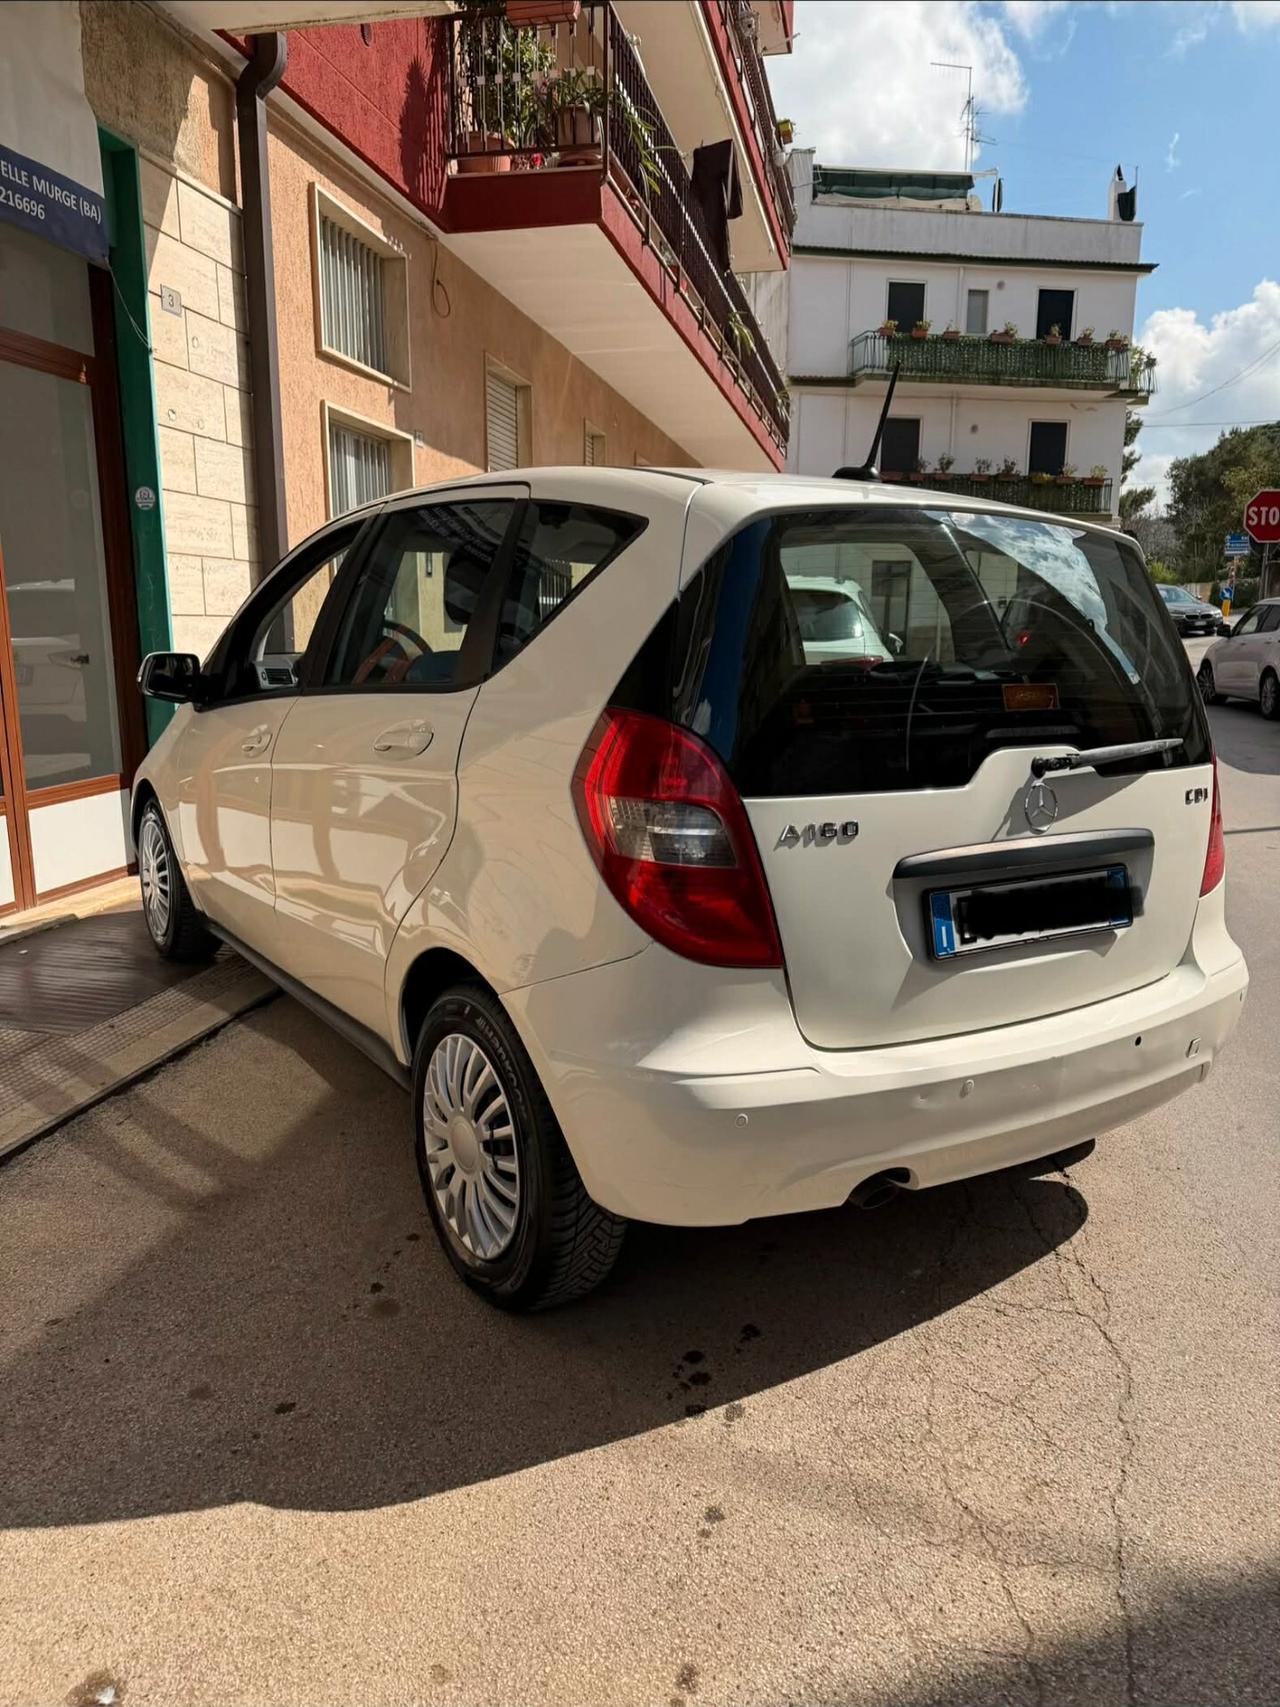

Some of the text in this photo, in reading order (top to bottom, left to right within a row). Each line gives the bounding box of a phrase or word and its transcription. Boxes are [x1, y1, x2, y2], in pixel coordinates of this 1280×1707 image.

[0, 185, 46, 220] 216696
[32, 175, 78, 210] MURGE
[79, 196, 102, 225] (BA)
[168, 293, 175, 308] 3
[1185, 787, 1208, 805] CDI
